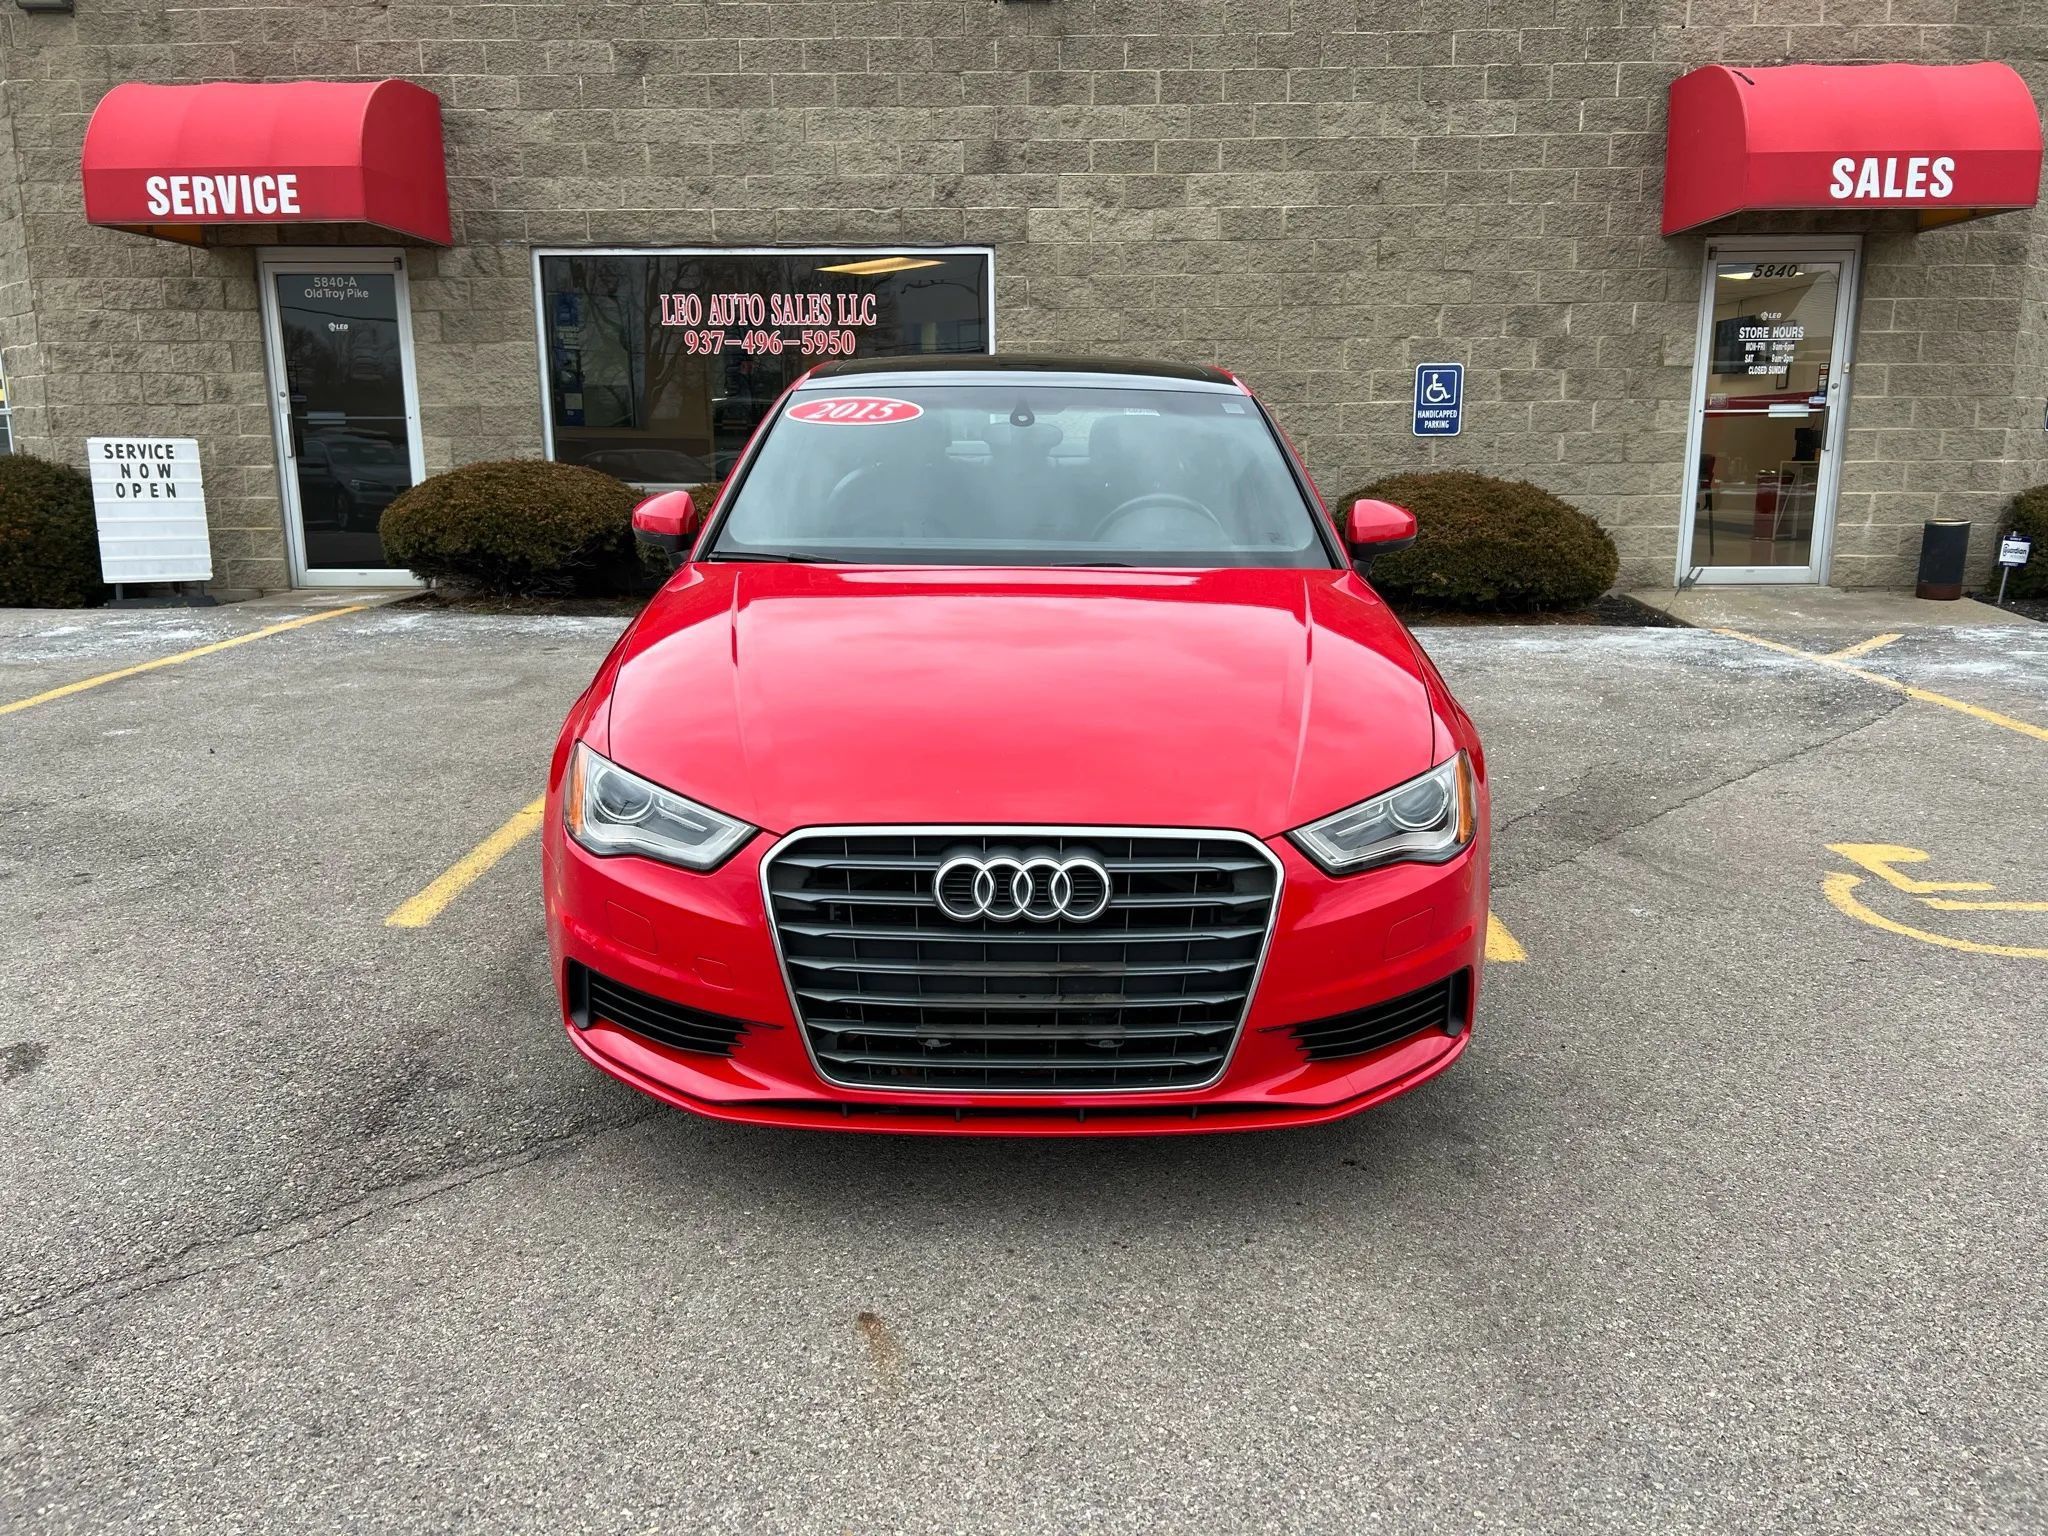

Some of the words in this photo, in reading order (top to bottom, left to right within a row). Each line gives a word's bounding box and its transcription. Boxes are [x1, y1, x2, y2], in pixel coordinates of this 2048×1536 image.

[1830, 157, 1955, 199] SALES
[146, 174, 301, 216] SERVICE
[1753, 264, 1798, 278] 5840
[313, 276, 358, 288] 5840-A
[304, 288, 323, 298] Old
[322, 288, 345, 301] Troy
[346, 288, 369, 298] Pike
[660, 293, 702, 326] LEO
[708, 293, 766, 326] AUTO
[770, 293, 832, 326] SALES
[837, 293, 877, 326] LLC
[1739, 327, 1769, 338] STORE
[1772, 326, 1804, 338] HOURS
[684, 330, 856, 355] 937-496-5950
[1744, 354, 1755, 363] SAT
[1748, 365, 1767, 375] CLOSED
[1768, 365, 1788, 375] SUNDAY
[803, 402, 903, 420] 2015
[1417, 410, 1458, 418] HANDICAPPED
[1424, 420, 1450, 429] PARKING
[103, 443, 175, 460] SERVICE
[120, 463, 171, 479] NOW
[115, 482, 177, 499] OPEN
